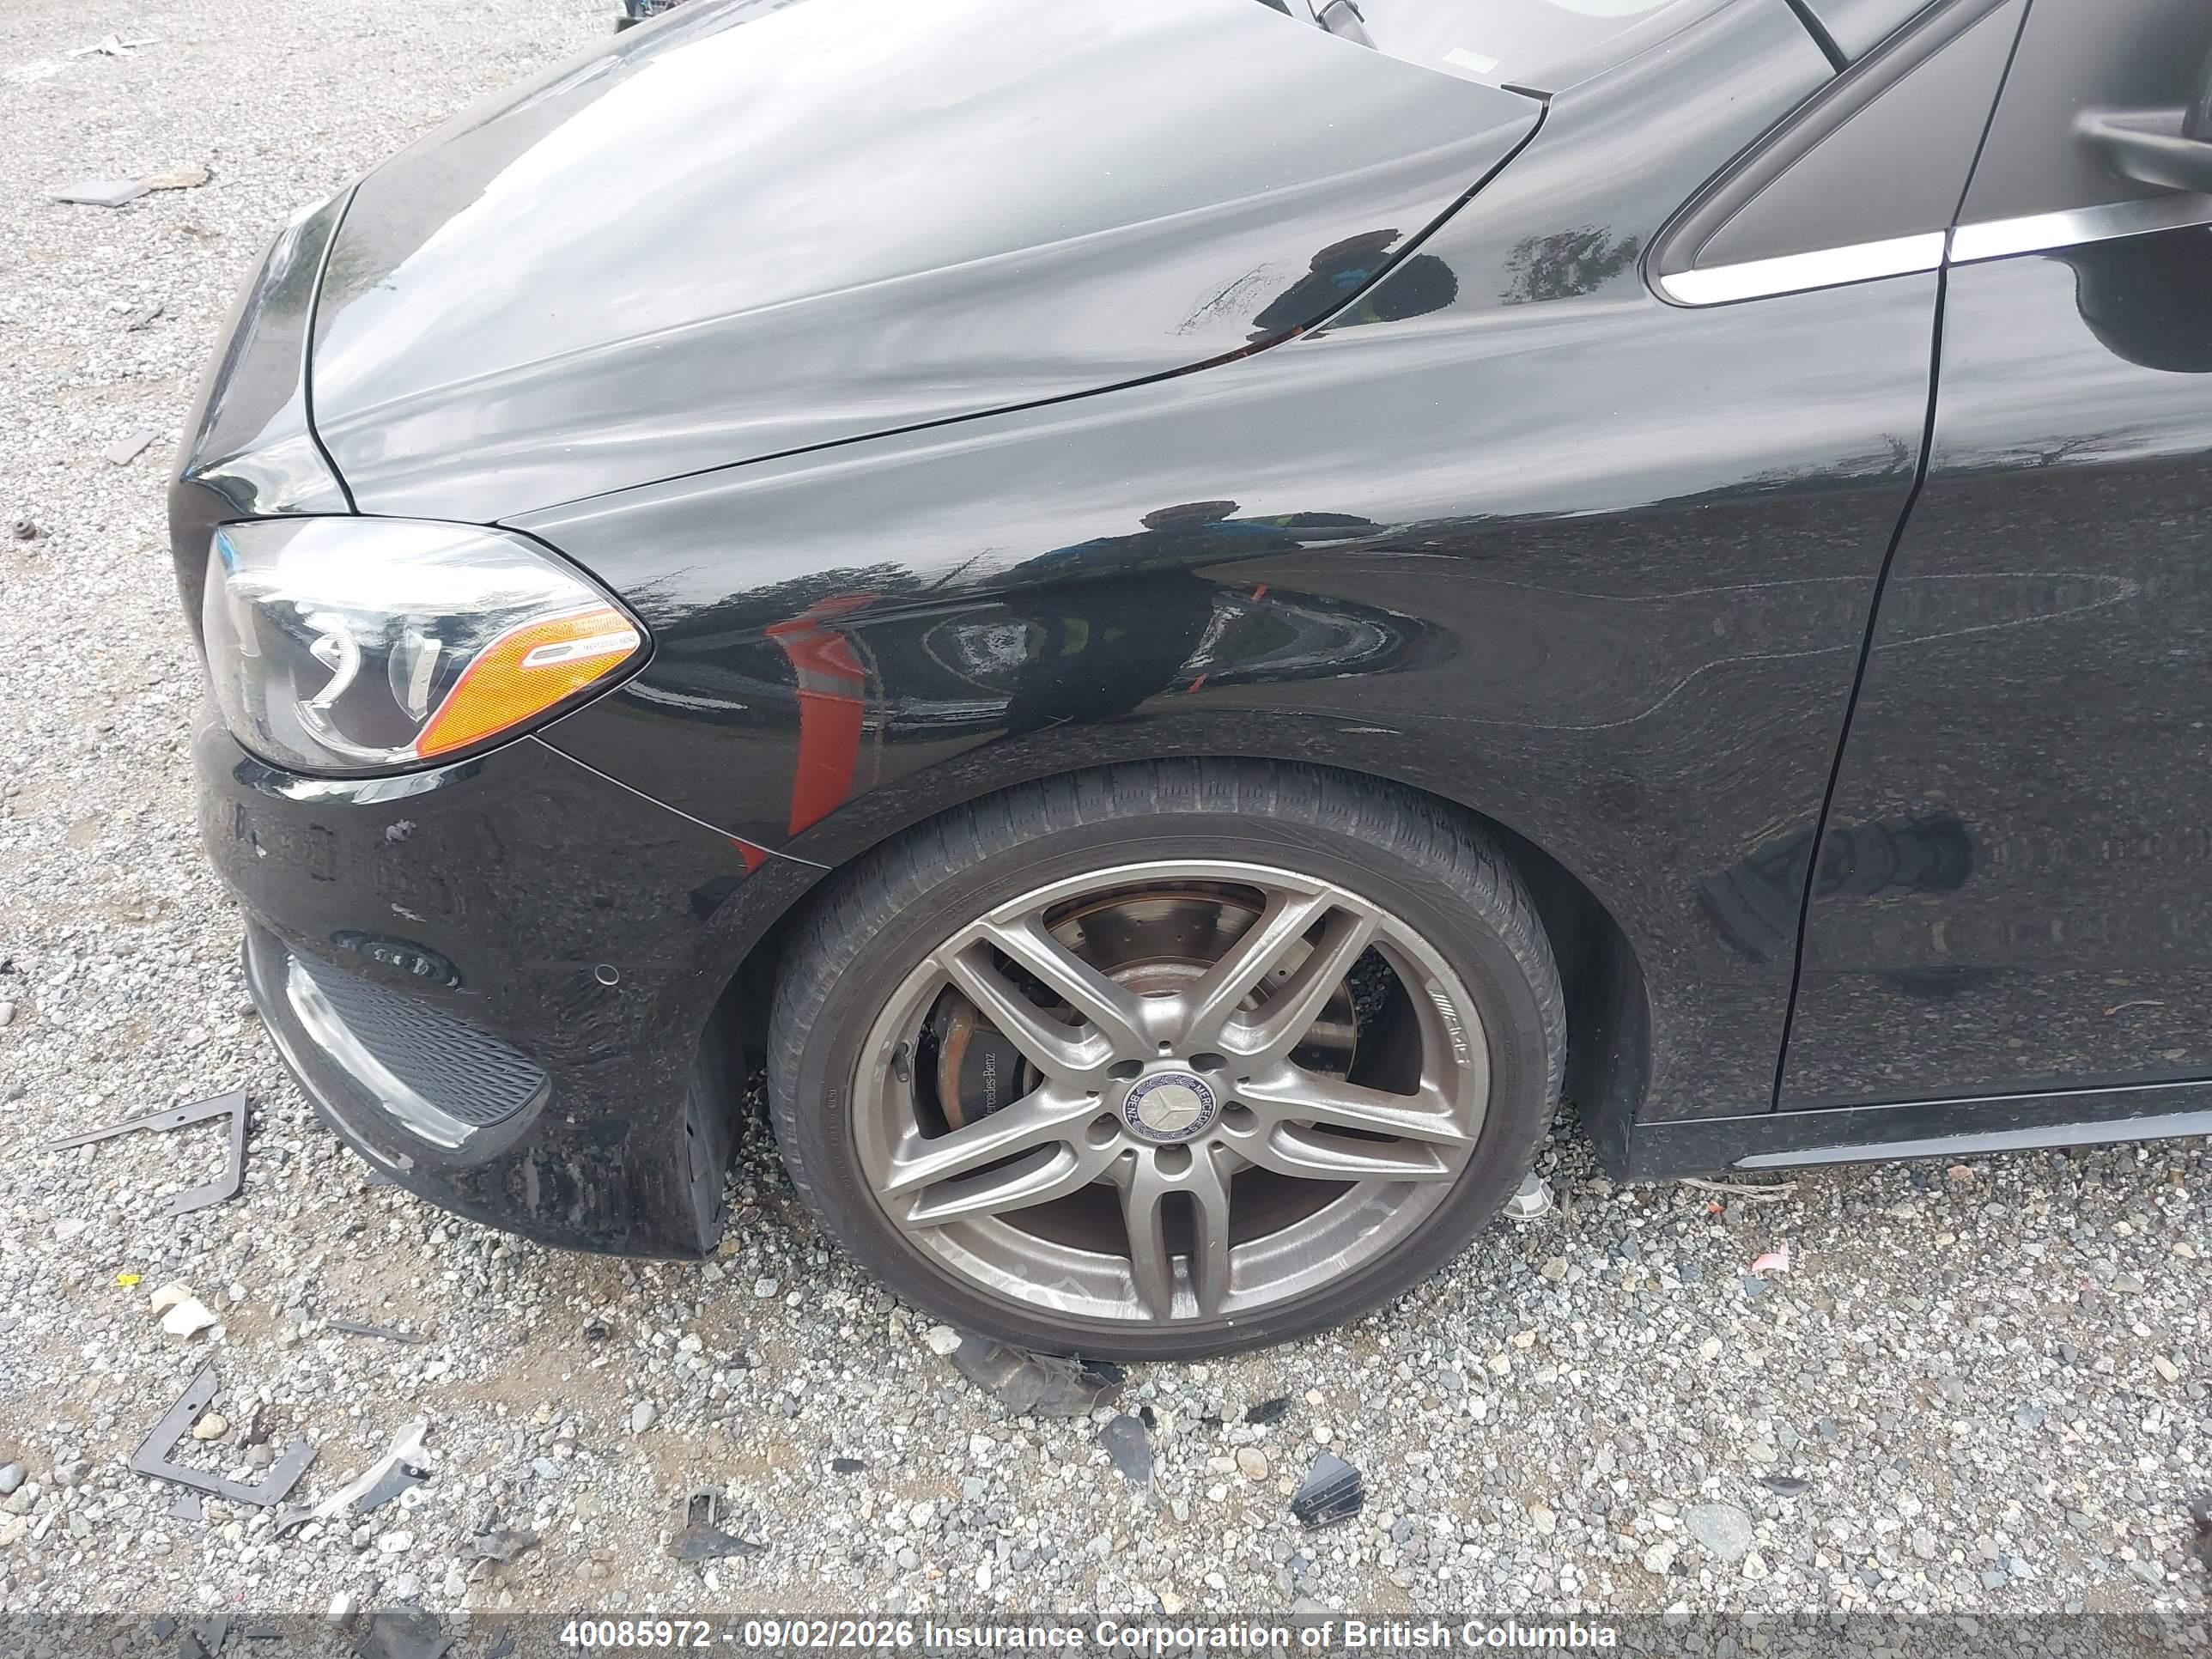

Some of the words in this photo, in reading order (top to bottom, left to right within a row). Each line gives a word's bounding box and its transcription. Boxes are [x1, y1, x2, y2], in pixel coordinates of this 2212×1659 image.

[982, 1053, 996, 1116] ercedes-Benz
[1126, 1093, 1140, 1122] BENZ
[1187, 1084, 1214, 1133] MERCEDES
